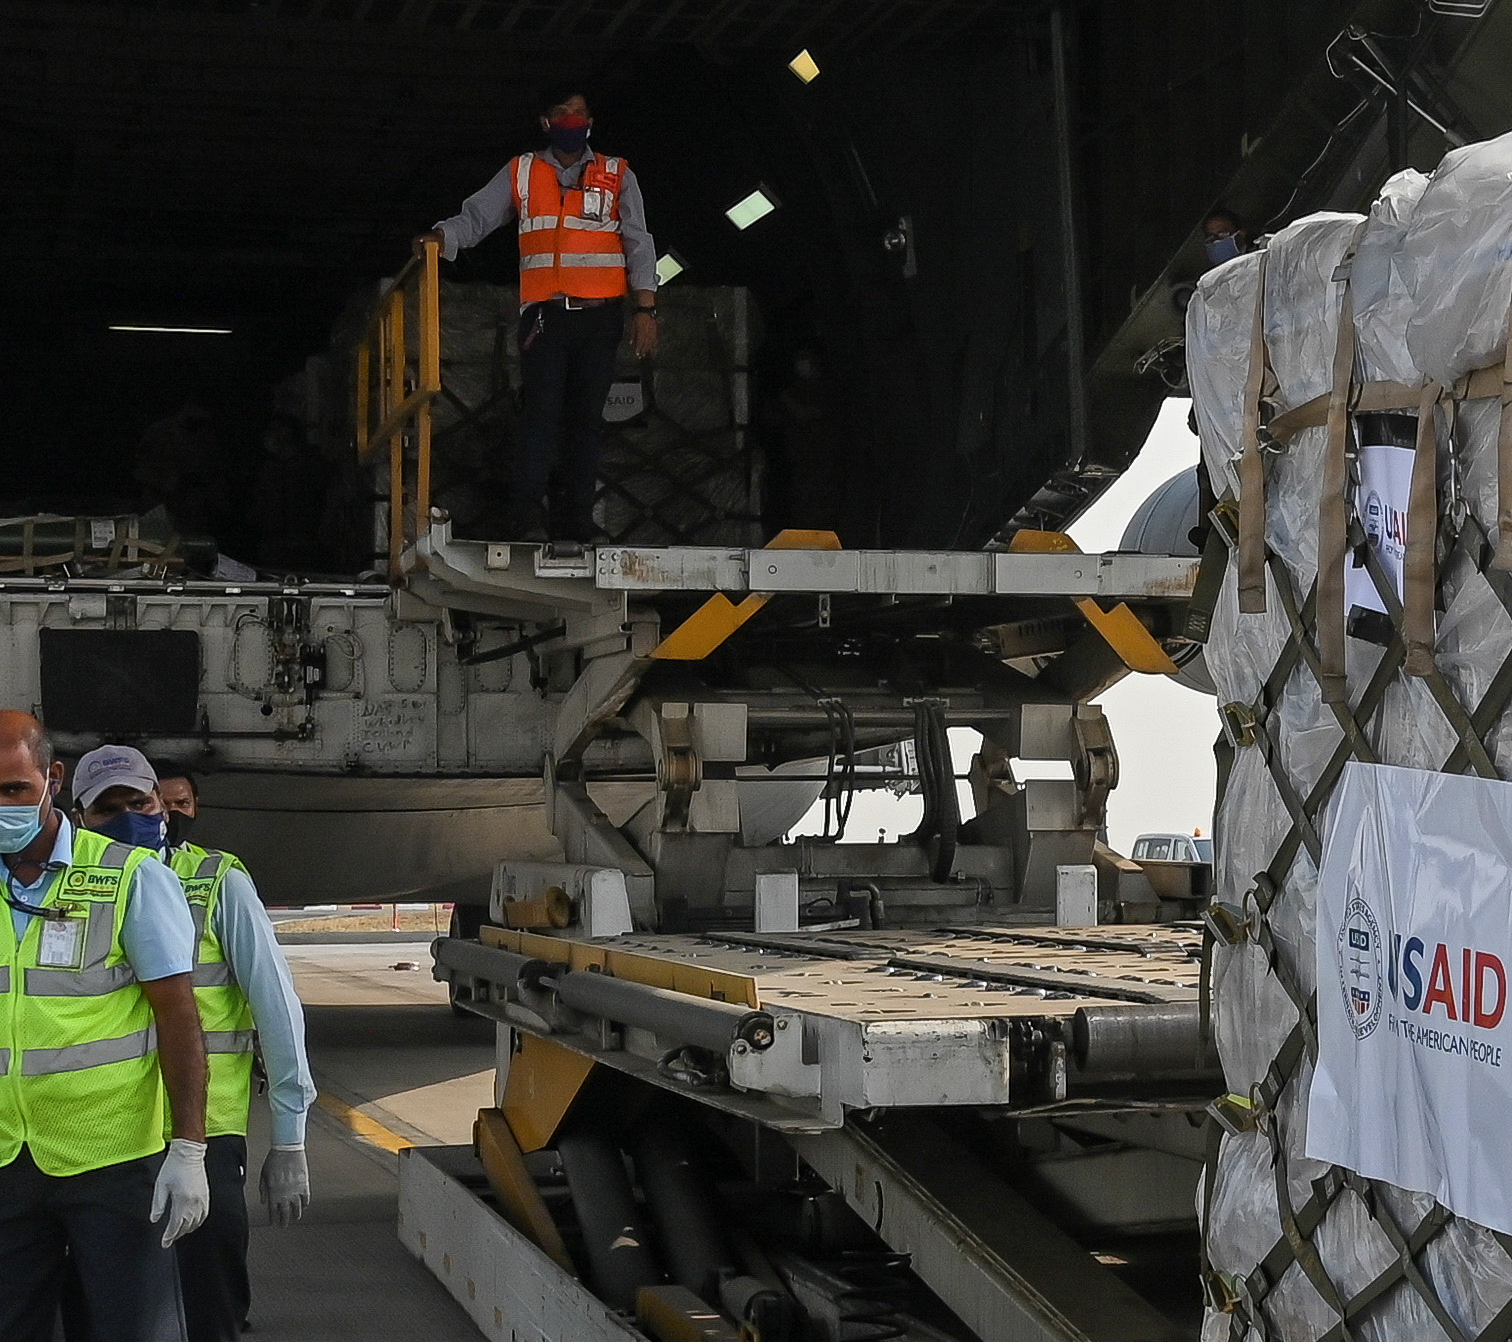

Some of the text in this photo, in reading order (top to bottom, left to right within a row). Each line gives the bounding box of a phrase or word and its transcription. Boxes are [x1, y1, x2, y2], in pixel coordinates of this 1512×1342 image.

[606, 395, 635, 405] SAID
[87, 873, 119, 886] BWFS
[184, 882, 212, 893] BWFS
[1416, 1026, 1468, 1057] AMERICAN
[1469, 1039, 1502, 1068] PEOPLE
